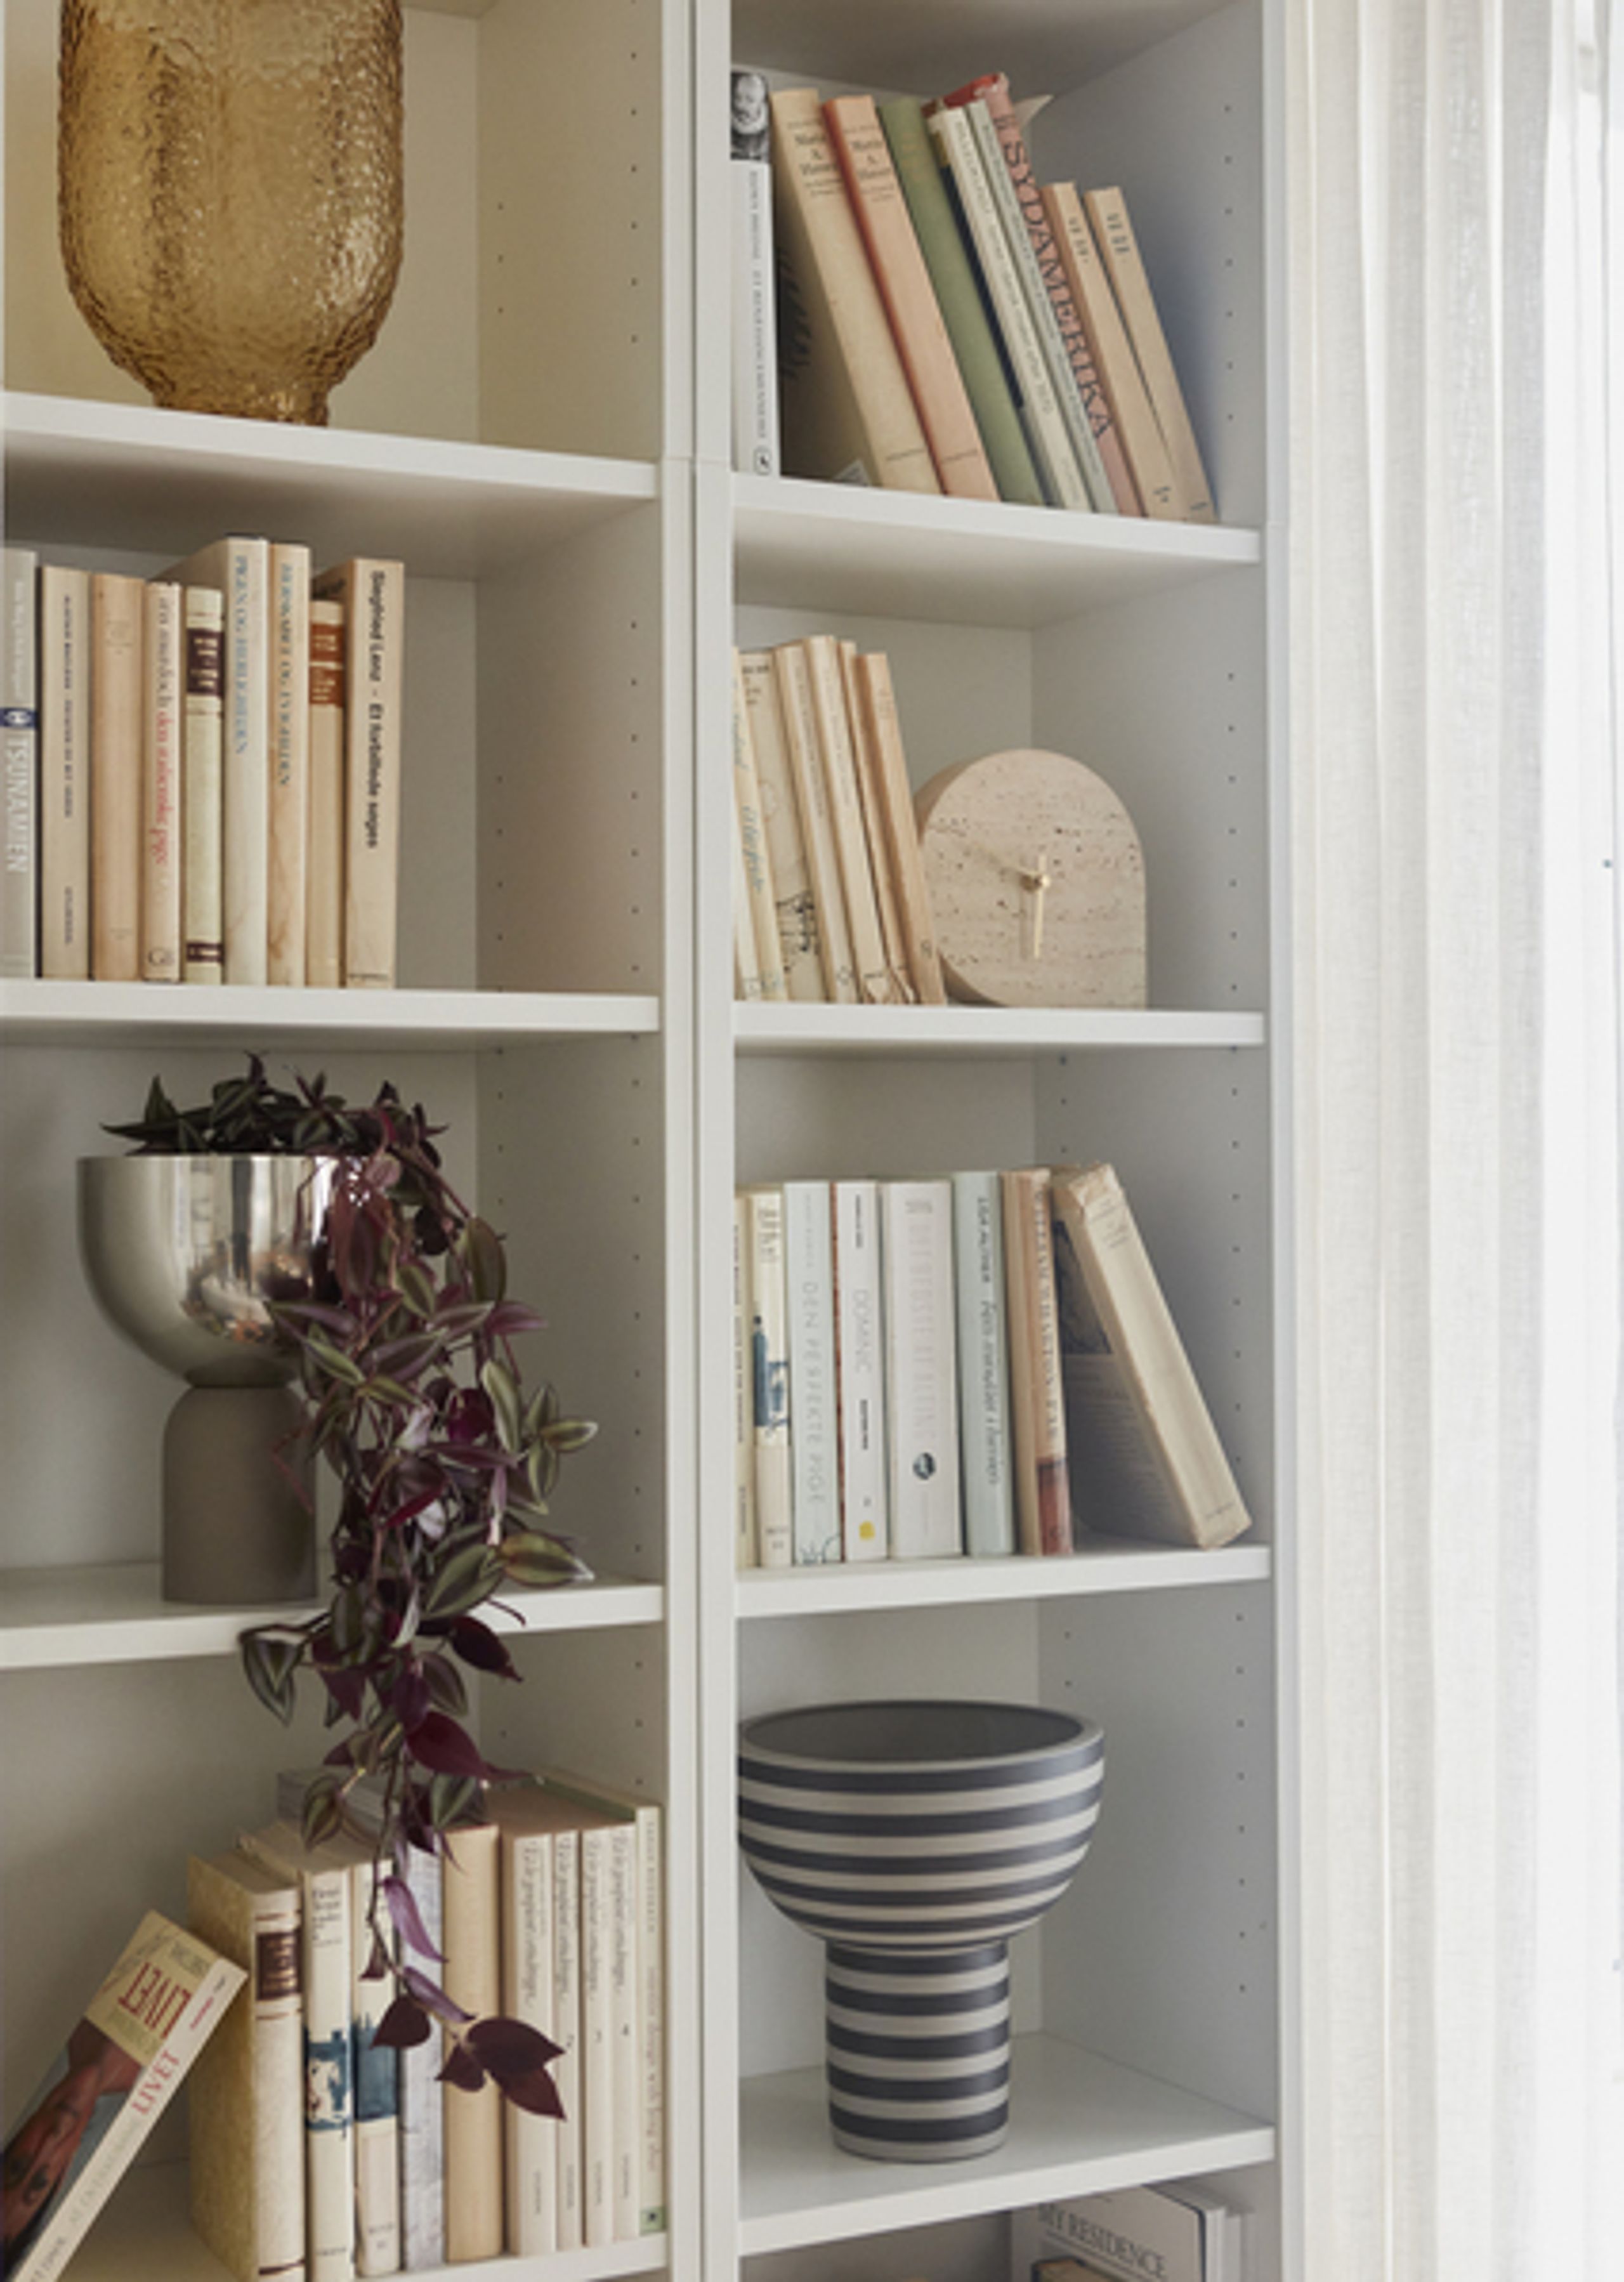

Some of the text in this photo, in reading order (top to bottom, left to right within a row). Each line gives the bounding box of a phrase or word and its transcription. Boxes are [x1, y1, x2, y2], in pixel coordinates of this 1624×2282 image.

[1003, 140, 1115, 440] SYDAMERIKA
[369, 571, 385, 639] Siegfried
[370, 643, 384, 682] Lenz
[369, 703, 384, 719] Et
[368, 723, 384, 796] forbillede
[6, 737, 29, 872] TSUNAMIEN
[365, 801, 381, 849] søges
[1034, 1188, 1052, 1282] WILLIAM
[802, 1282, 819, 1329] DEN
[853, 1289, 874, 1374] DOMINIC
[805, 1339, 823, 1444] PERFEKTE
[117, 1962, 192, 2039] LIVET
[131, 2049, 180, 2115] LIVET
[1067, 2212, 1168, 2280] RESIDENCE
